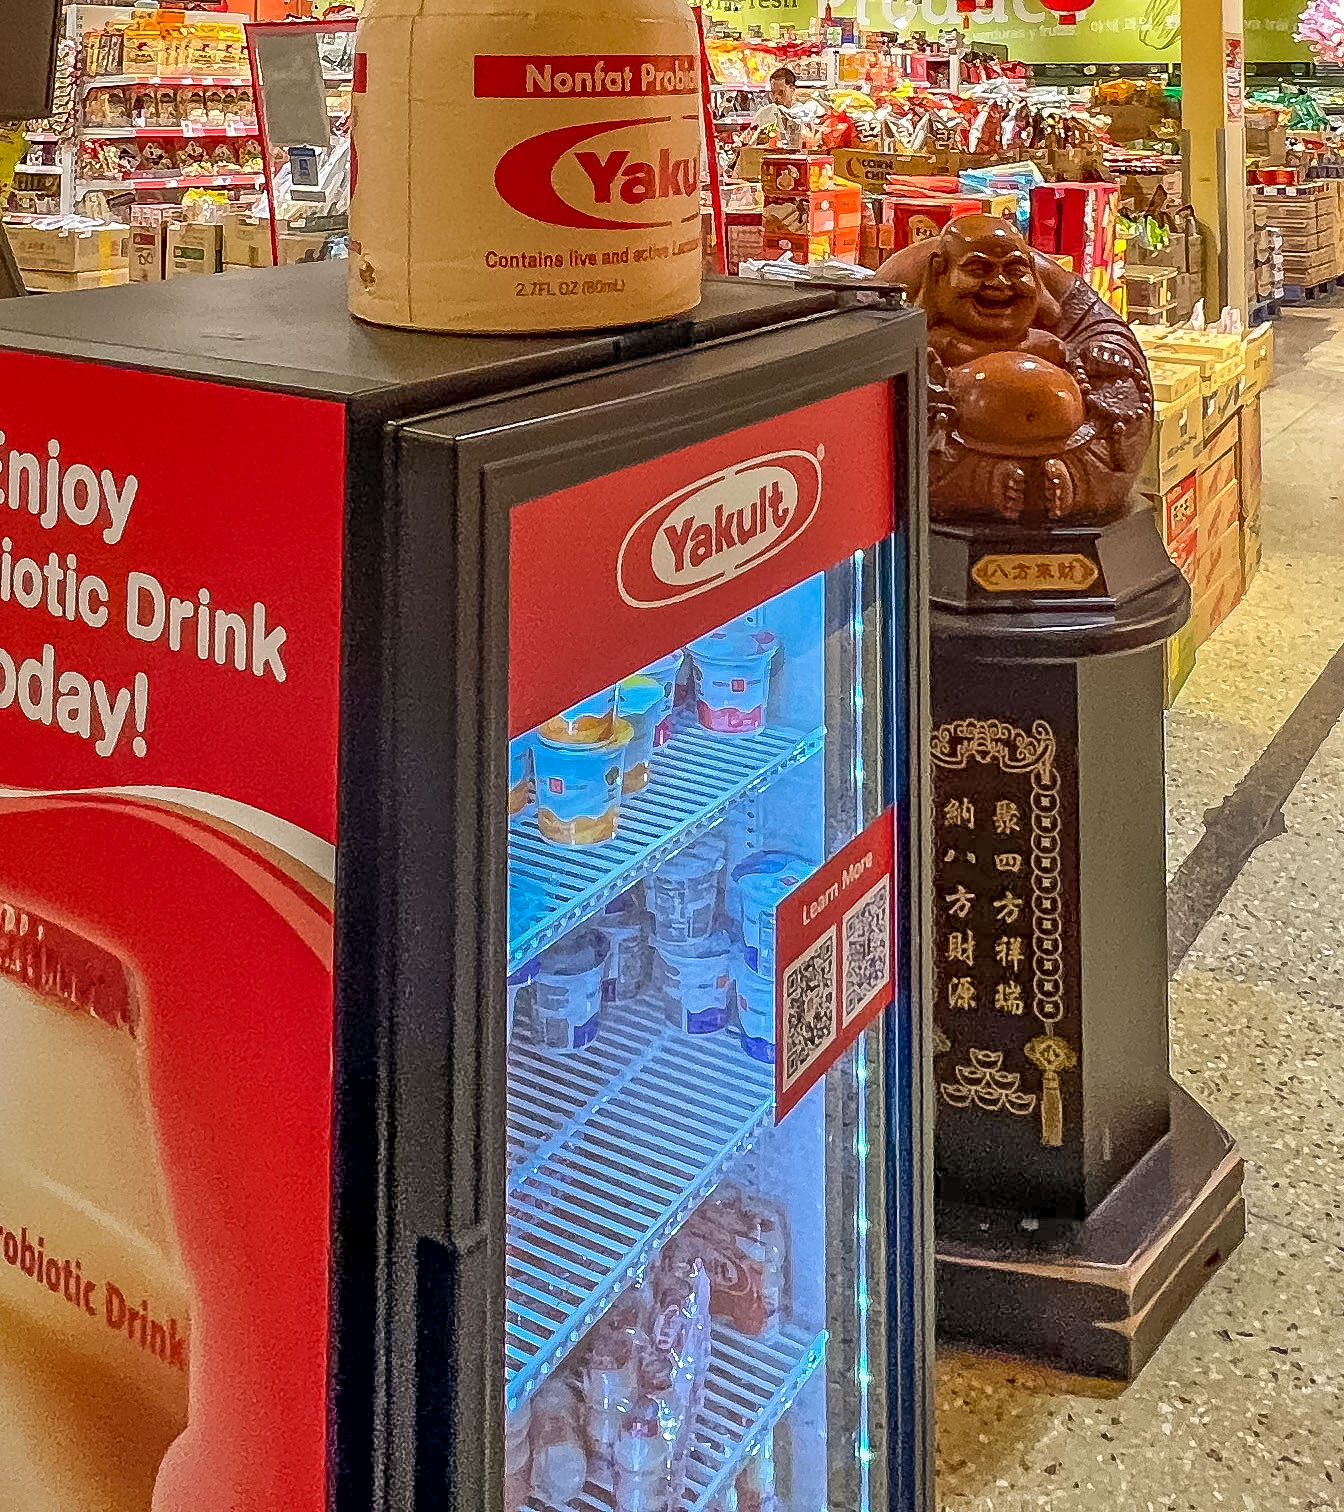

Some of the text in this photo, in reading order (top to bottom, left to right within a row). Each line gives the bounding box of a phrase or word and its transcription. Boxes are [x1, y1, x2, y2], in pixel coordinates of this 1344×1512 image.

[526, 61, 633, 93] Nonfat
[574, 148, 699, 206] Yaku
[485, 250, 564, 269] Contains
[569, 249, 598, 267] live
[602, 247, 630, 265] and
[663, 481, 789, 573] Yakult
[126, 571, 288, 683] Drink
[802, 850, 874, 927] Learn More
[105, 1281, 189, 1371] Drink
